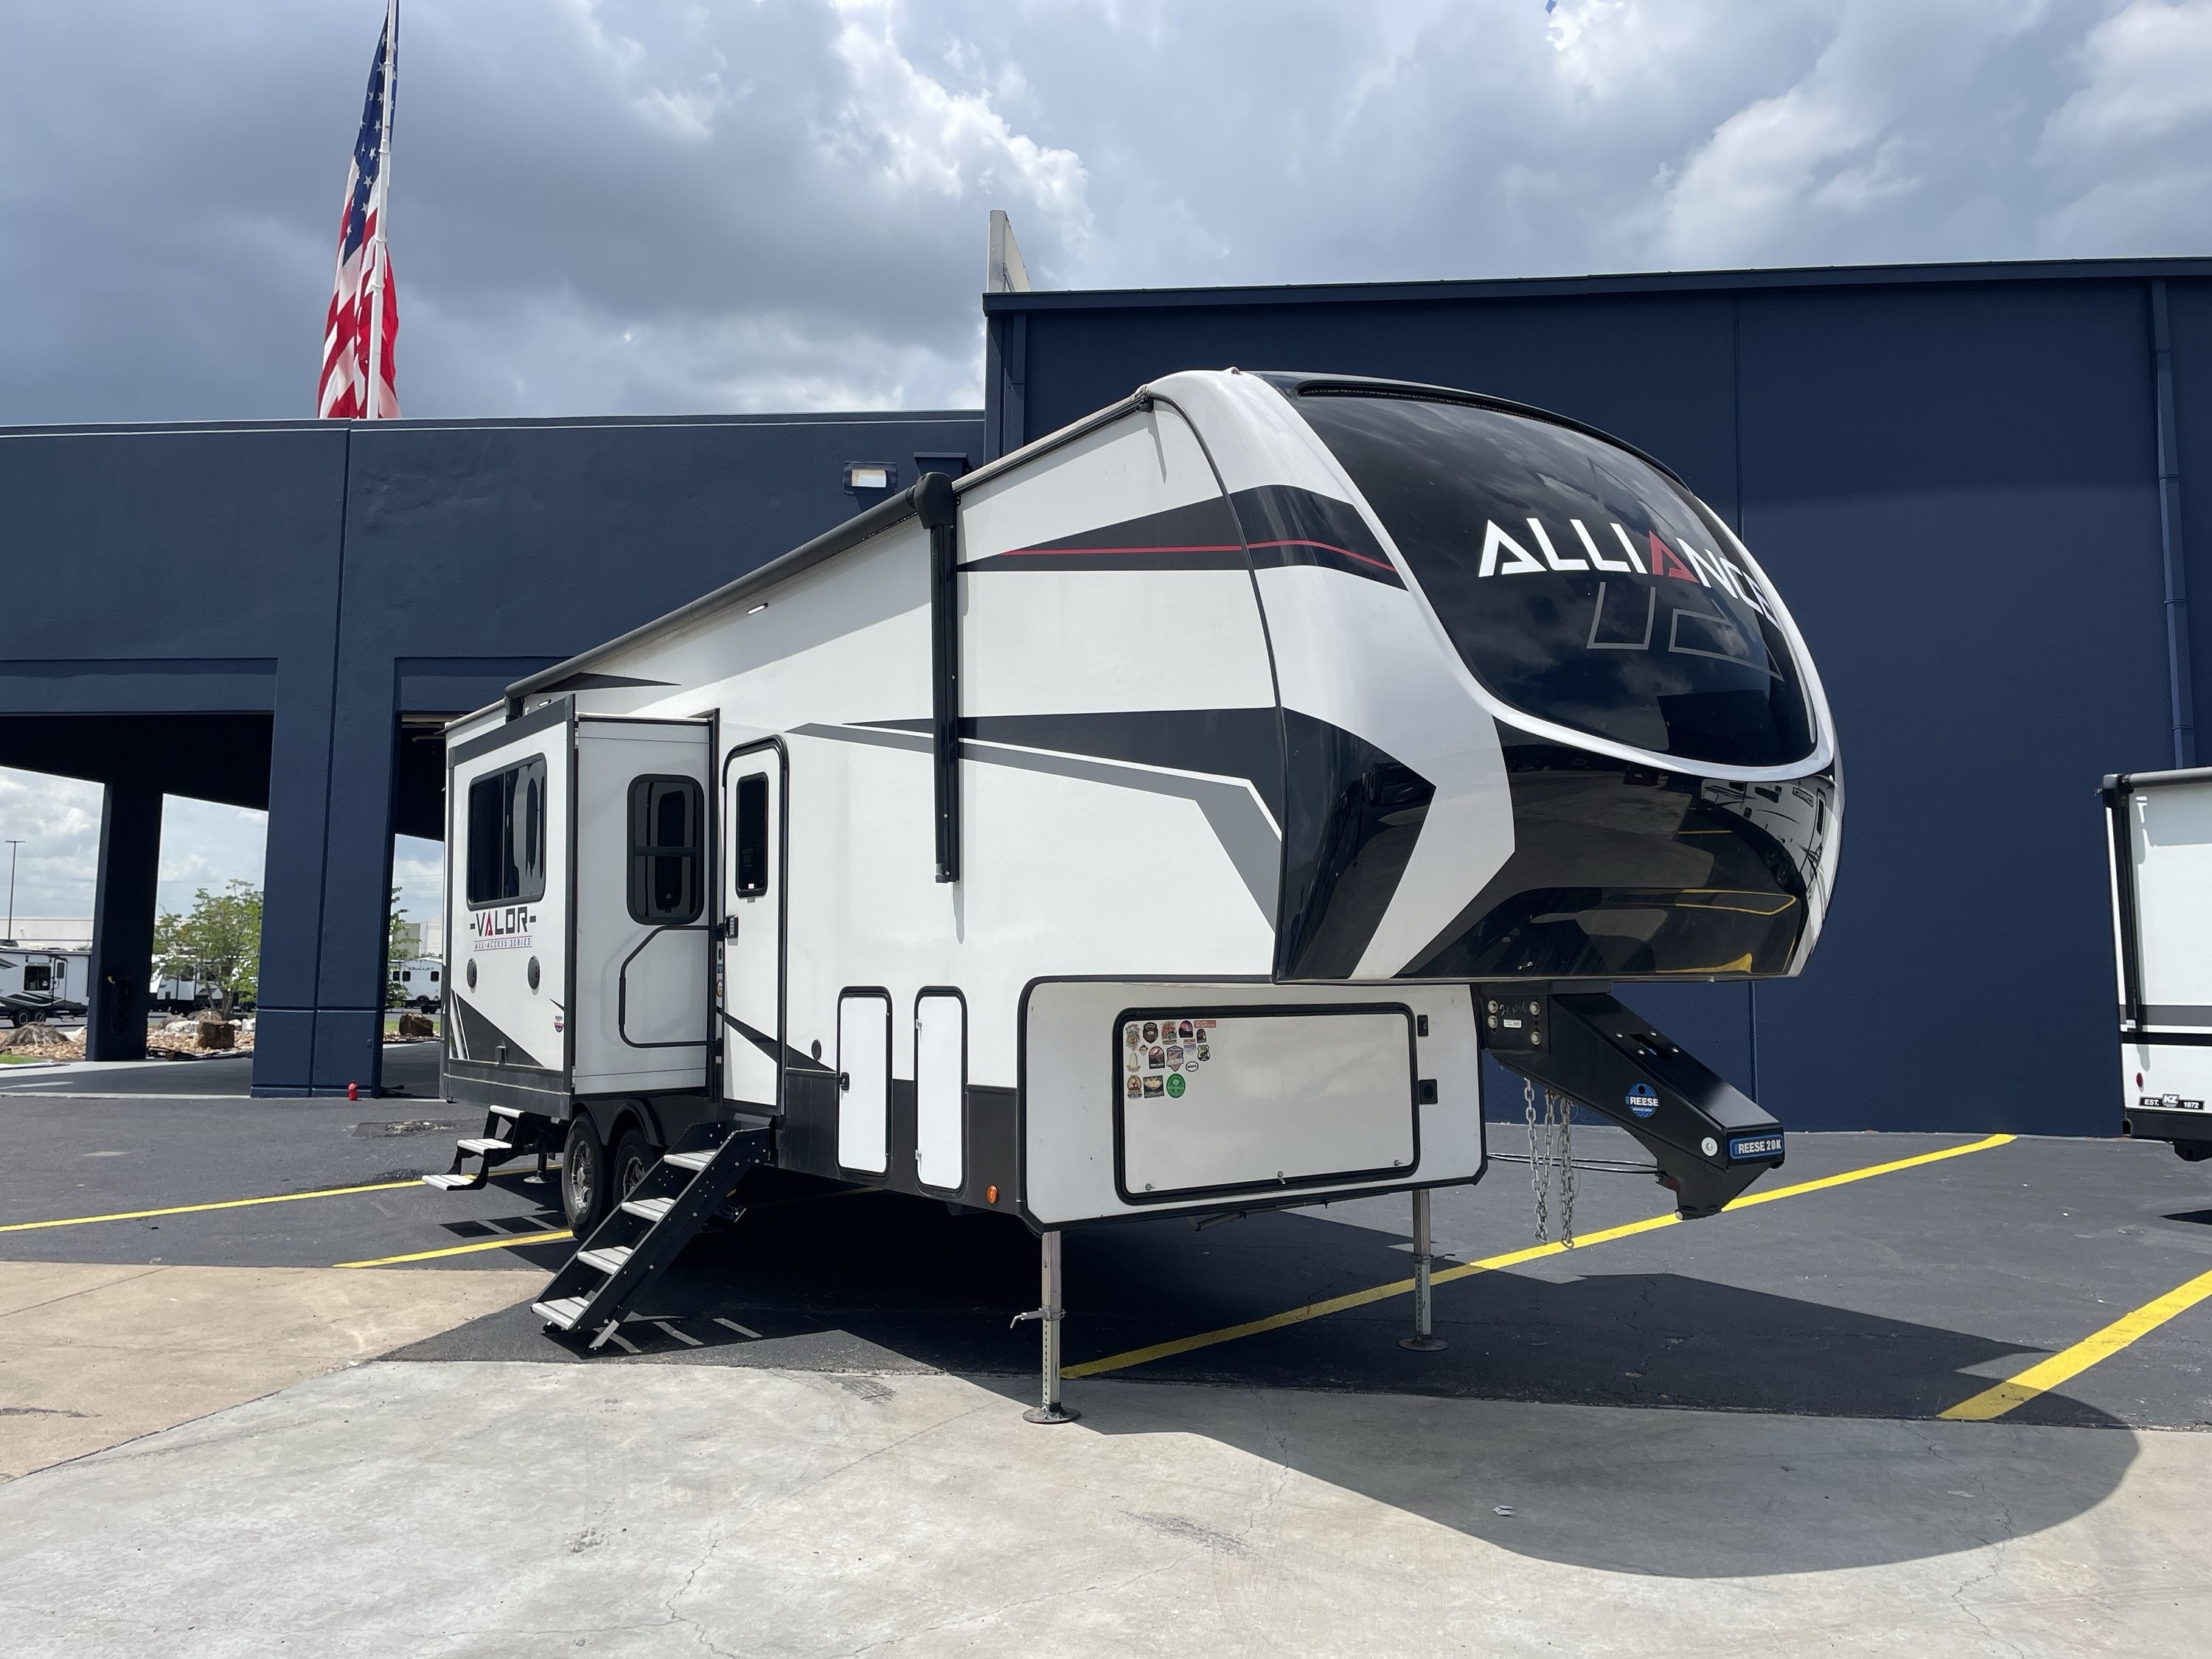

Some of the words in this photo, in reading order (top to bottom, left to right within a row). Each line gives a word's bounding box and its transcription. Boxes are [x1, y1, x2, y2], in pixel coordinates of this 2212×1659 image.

[1478, 518, 1783, 632] ALLIANCE
[475, 940, 507, 949] ALL-ACCESS
[510, 938, 530, 946] SERIES
[1630, 1096, 1659, 1107] REESE
[1739, 1141, 1765, 1154] REESE
[1767, 1139, 1781, 1150] 20K
